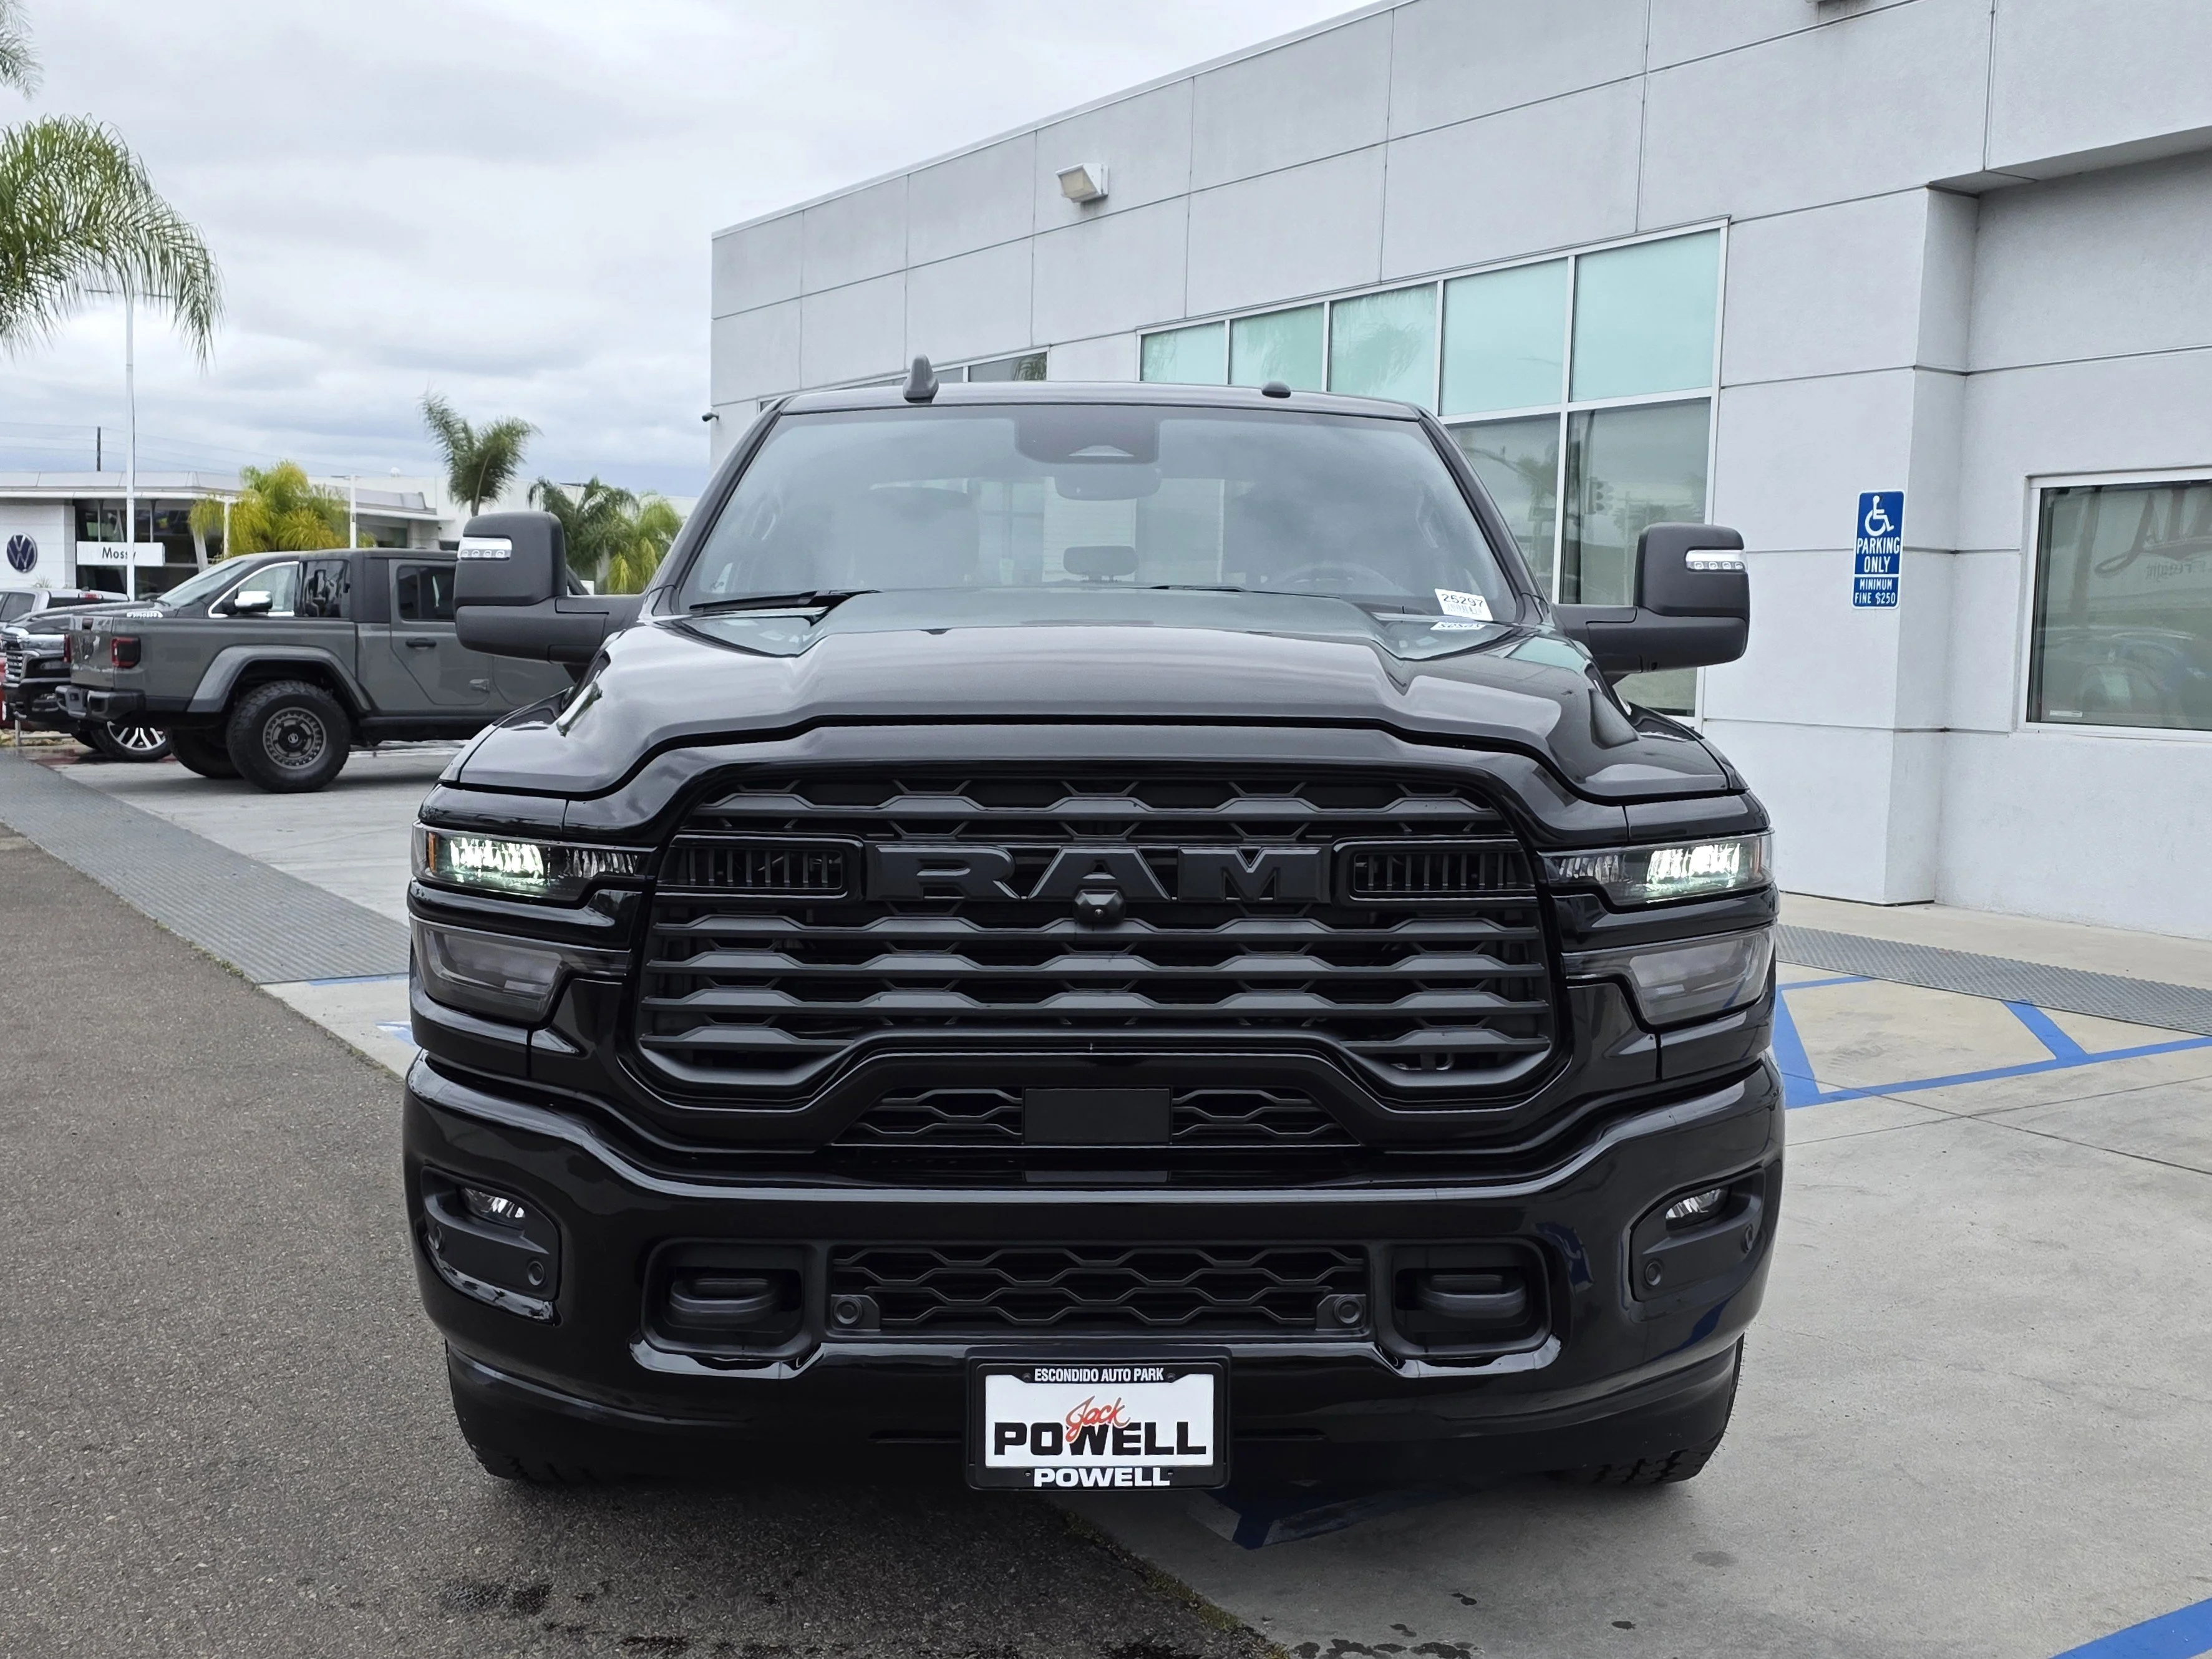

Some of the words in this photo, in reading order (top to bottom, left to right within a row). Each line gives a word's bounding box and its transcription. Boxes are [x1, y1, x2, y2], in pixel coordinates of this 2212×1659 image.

[1857, 537, 1900, 554] PARKING
[1864, 556, 1891, 573] ONLY
[1860, 579, 1892, 590] MINIMUM
[1442, 594, 1483, 607] 25297
[1855, 592, 1871, 604] FINE
[1875, 591, 1896, 604] $250
[875, 844, 1325, 902] RAM
[1034, 1368, 1098, 1383] ESCONDIDO
[1101, 1368, 1131, 1382] AUTO
[1133, 1368, 1164, 1381] PARK
[1065, 1395, 1131, 1443] Jack
[994, 1421, 1207, 1456] POWELL
[1033, 1467, 1171, 1487] POWELL
